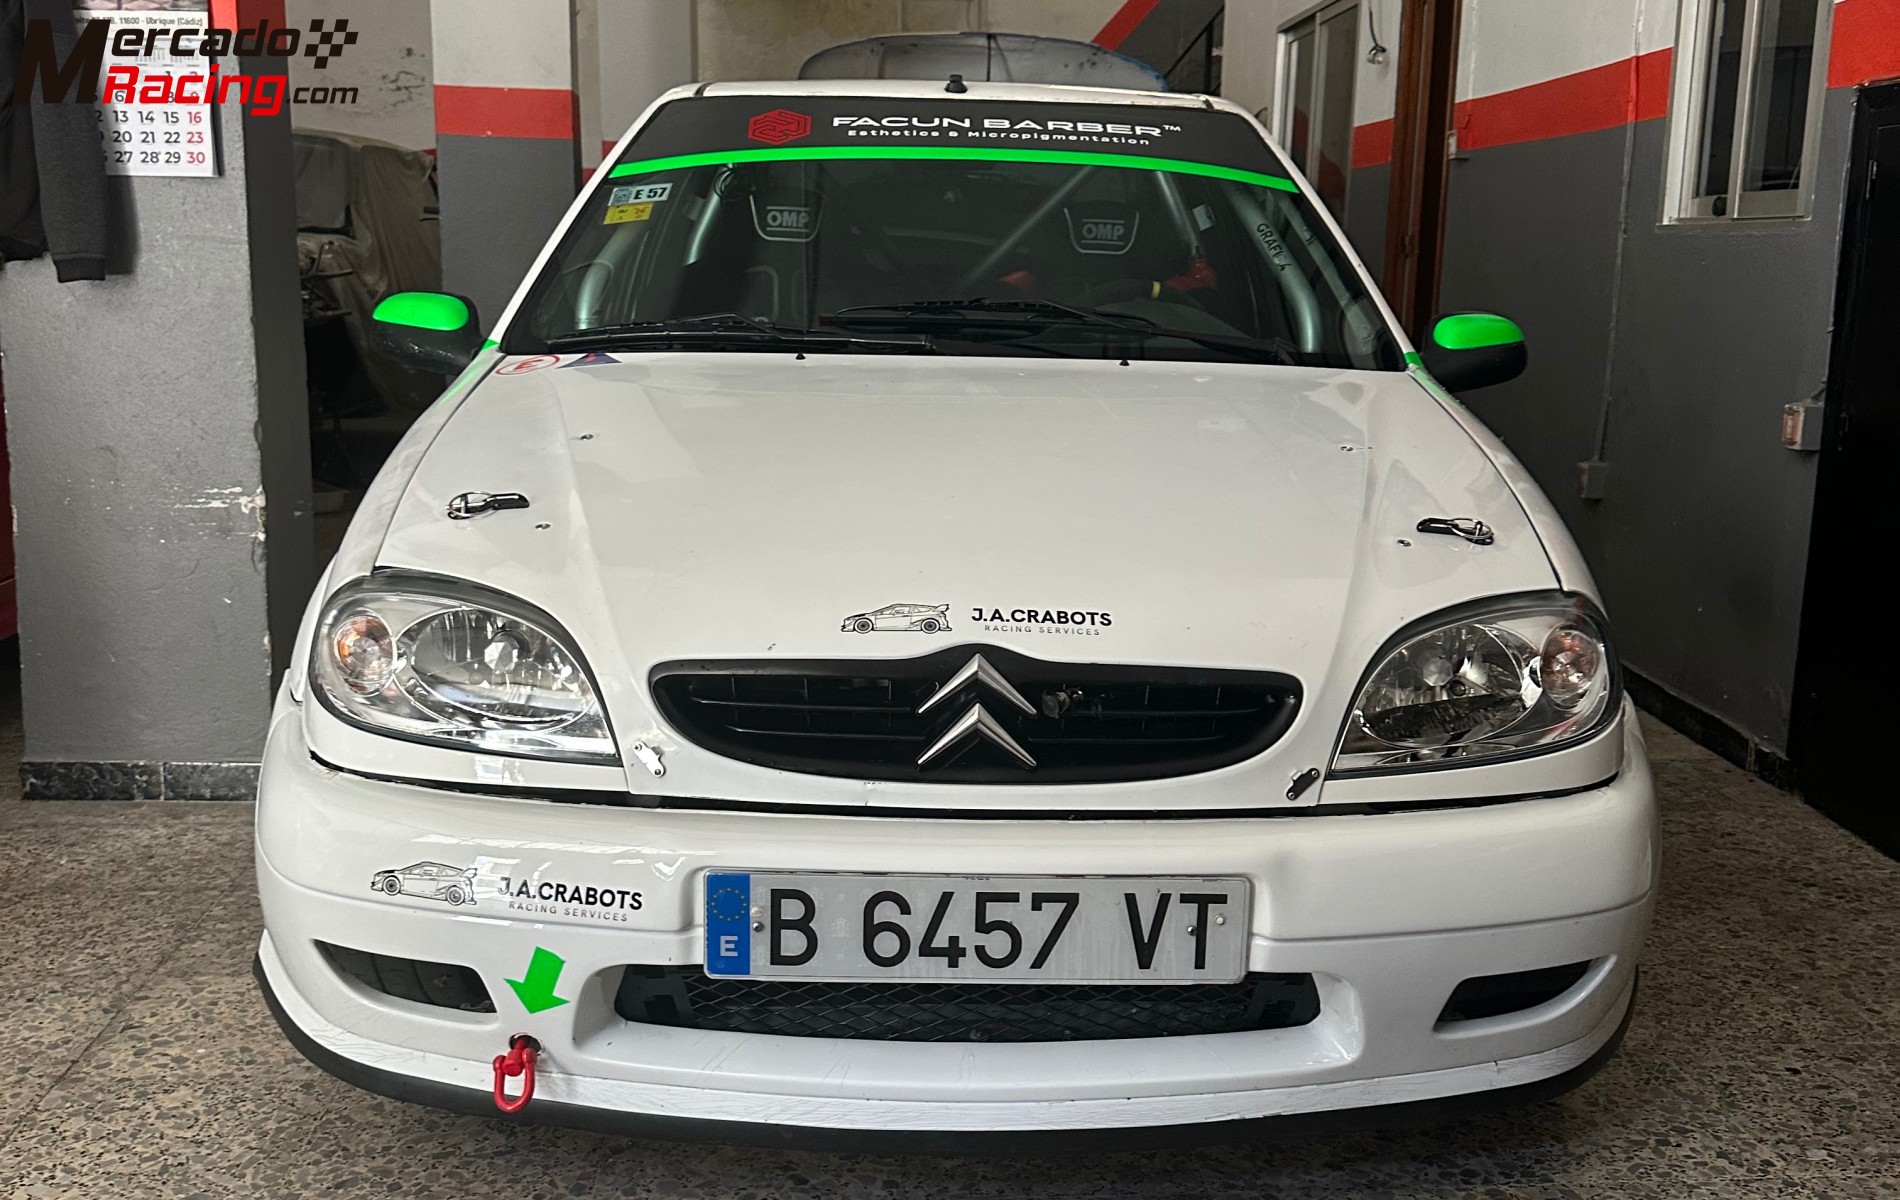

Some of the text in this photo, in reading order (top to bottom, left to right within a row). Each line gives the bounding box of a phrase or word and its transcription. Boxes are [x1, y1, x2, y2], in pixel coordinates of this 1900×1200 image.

[120, 17, 140, 25] 11600
[146, 17, 176, 26] Ubrique
[177, 17, 203, 26] (Cádiz)
[113, 110, 129, 123] 13
[138, 110, 156, 123] 14
[163, 111, 180, 124] 15
[187, 111, 203, 124] 16
[832, 116, 971, 128] FACUN
[112, 131, 133, 143] 20
[140, 131, 156, 144] 21
[164, 131, 181, 144] 22
[186, 131, 204, 144] 23
[847, 129, 940, 137] Esthetics
[967, 131, 1150, 145] Micropigmentation
[114, 151, 133, 163] 27
[140, 151, 160, 164] 28
[164, 151, 181, 164] 29
[186, 151, 206, 164] 30
[633, 187, 668, 200] E 57
[766, 210, 810, 228] OMP
[1082, 223, 1125, 240] OMP
[971, 607, 1113, 627] J.A.CRABOTS
[984, 624, 1101, 636] RACING SERVICES
[497, 876, 643, 911] J.A.CRABOTS
[508, 901, 628, 922] RACING SERVICES
[769, 888, 1229, 970] B 6457 VT
[719, 935, 739, 957] E
